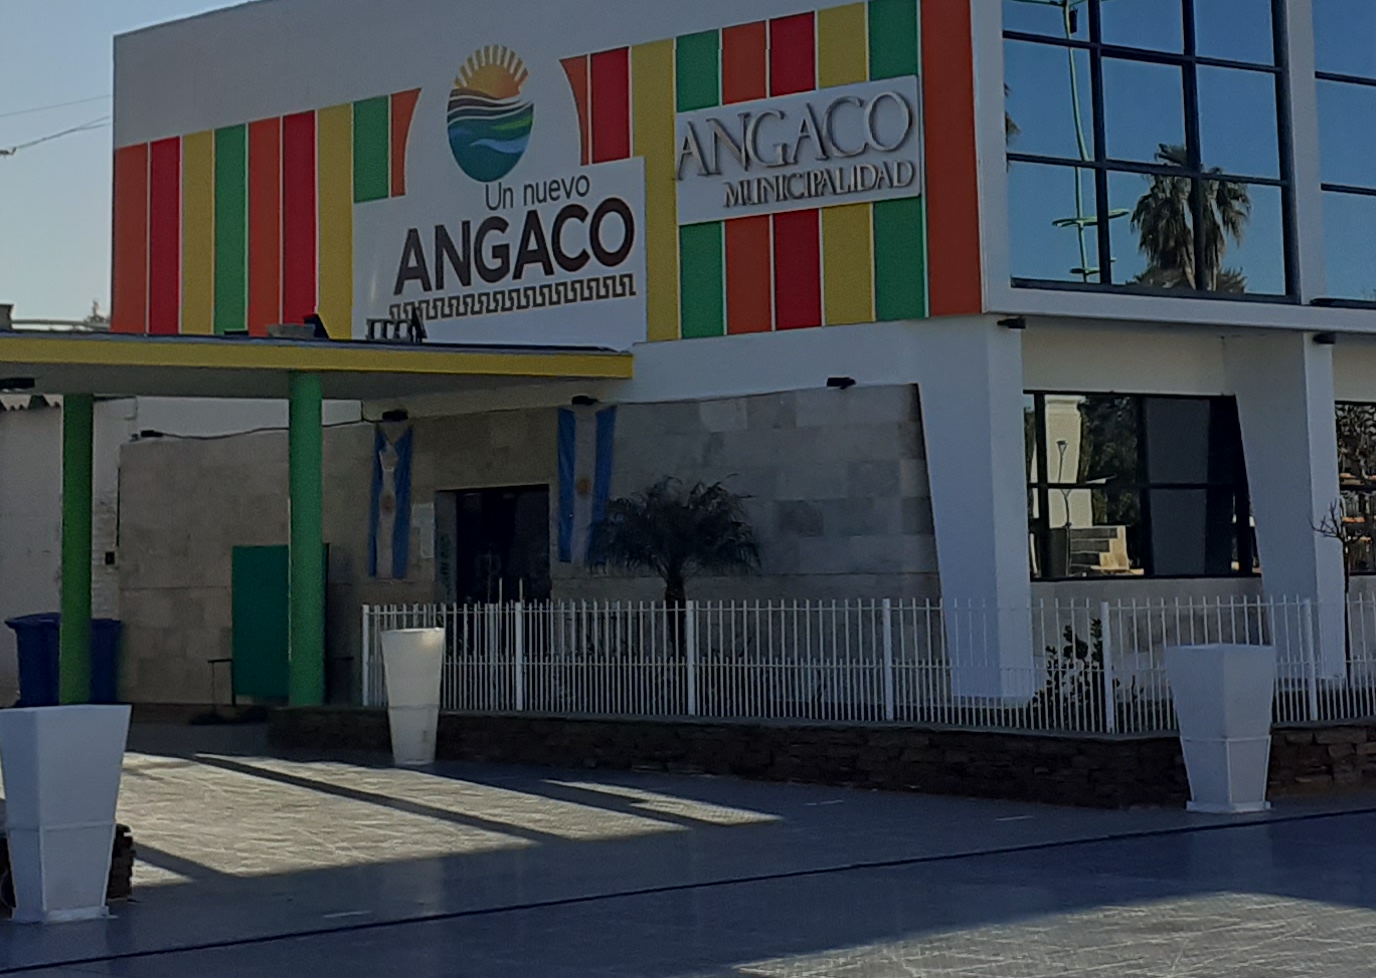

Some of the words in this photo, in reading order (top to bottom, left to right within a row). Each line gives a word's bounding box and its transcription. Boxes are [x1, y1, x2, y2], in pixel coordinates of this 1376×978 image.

[676, 90, 916, 181] ANGACO
[485, 181, 515, 212] Un
[524, 174, 591, 203] nuevo
[723, 159, 916, 210] MUNICIPALIDAD
[392, 196, 635, 296] ANGACO
